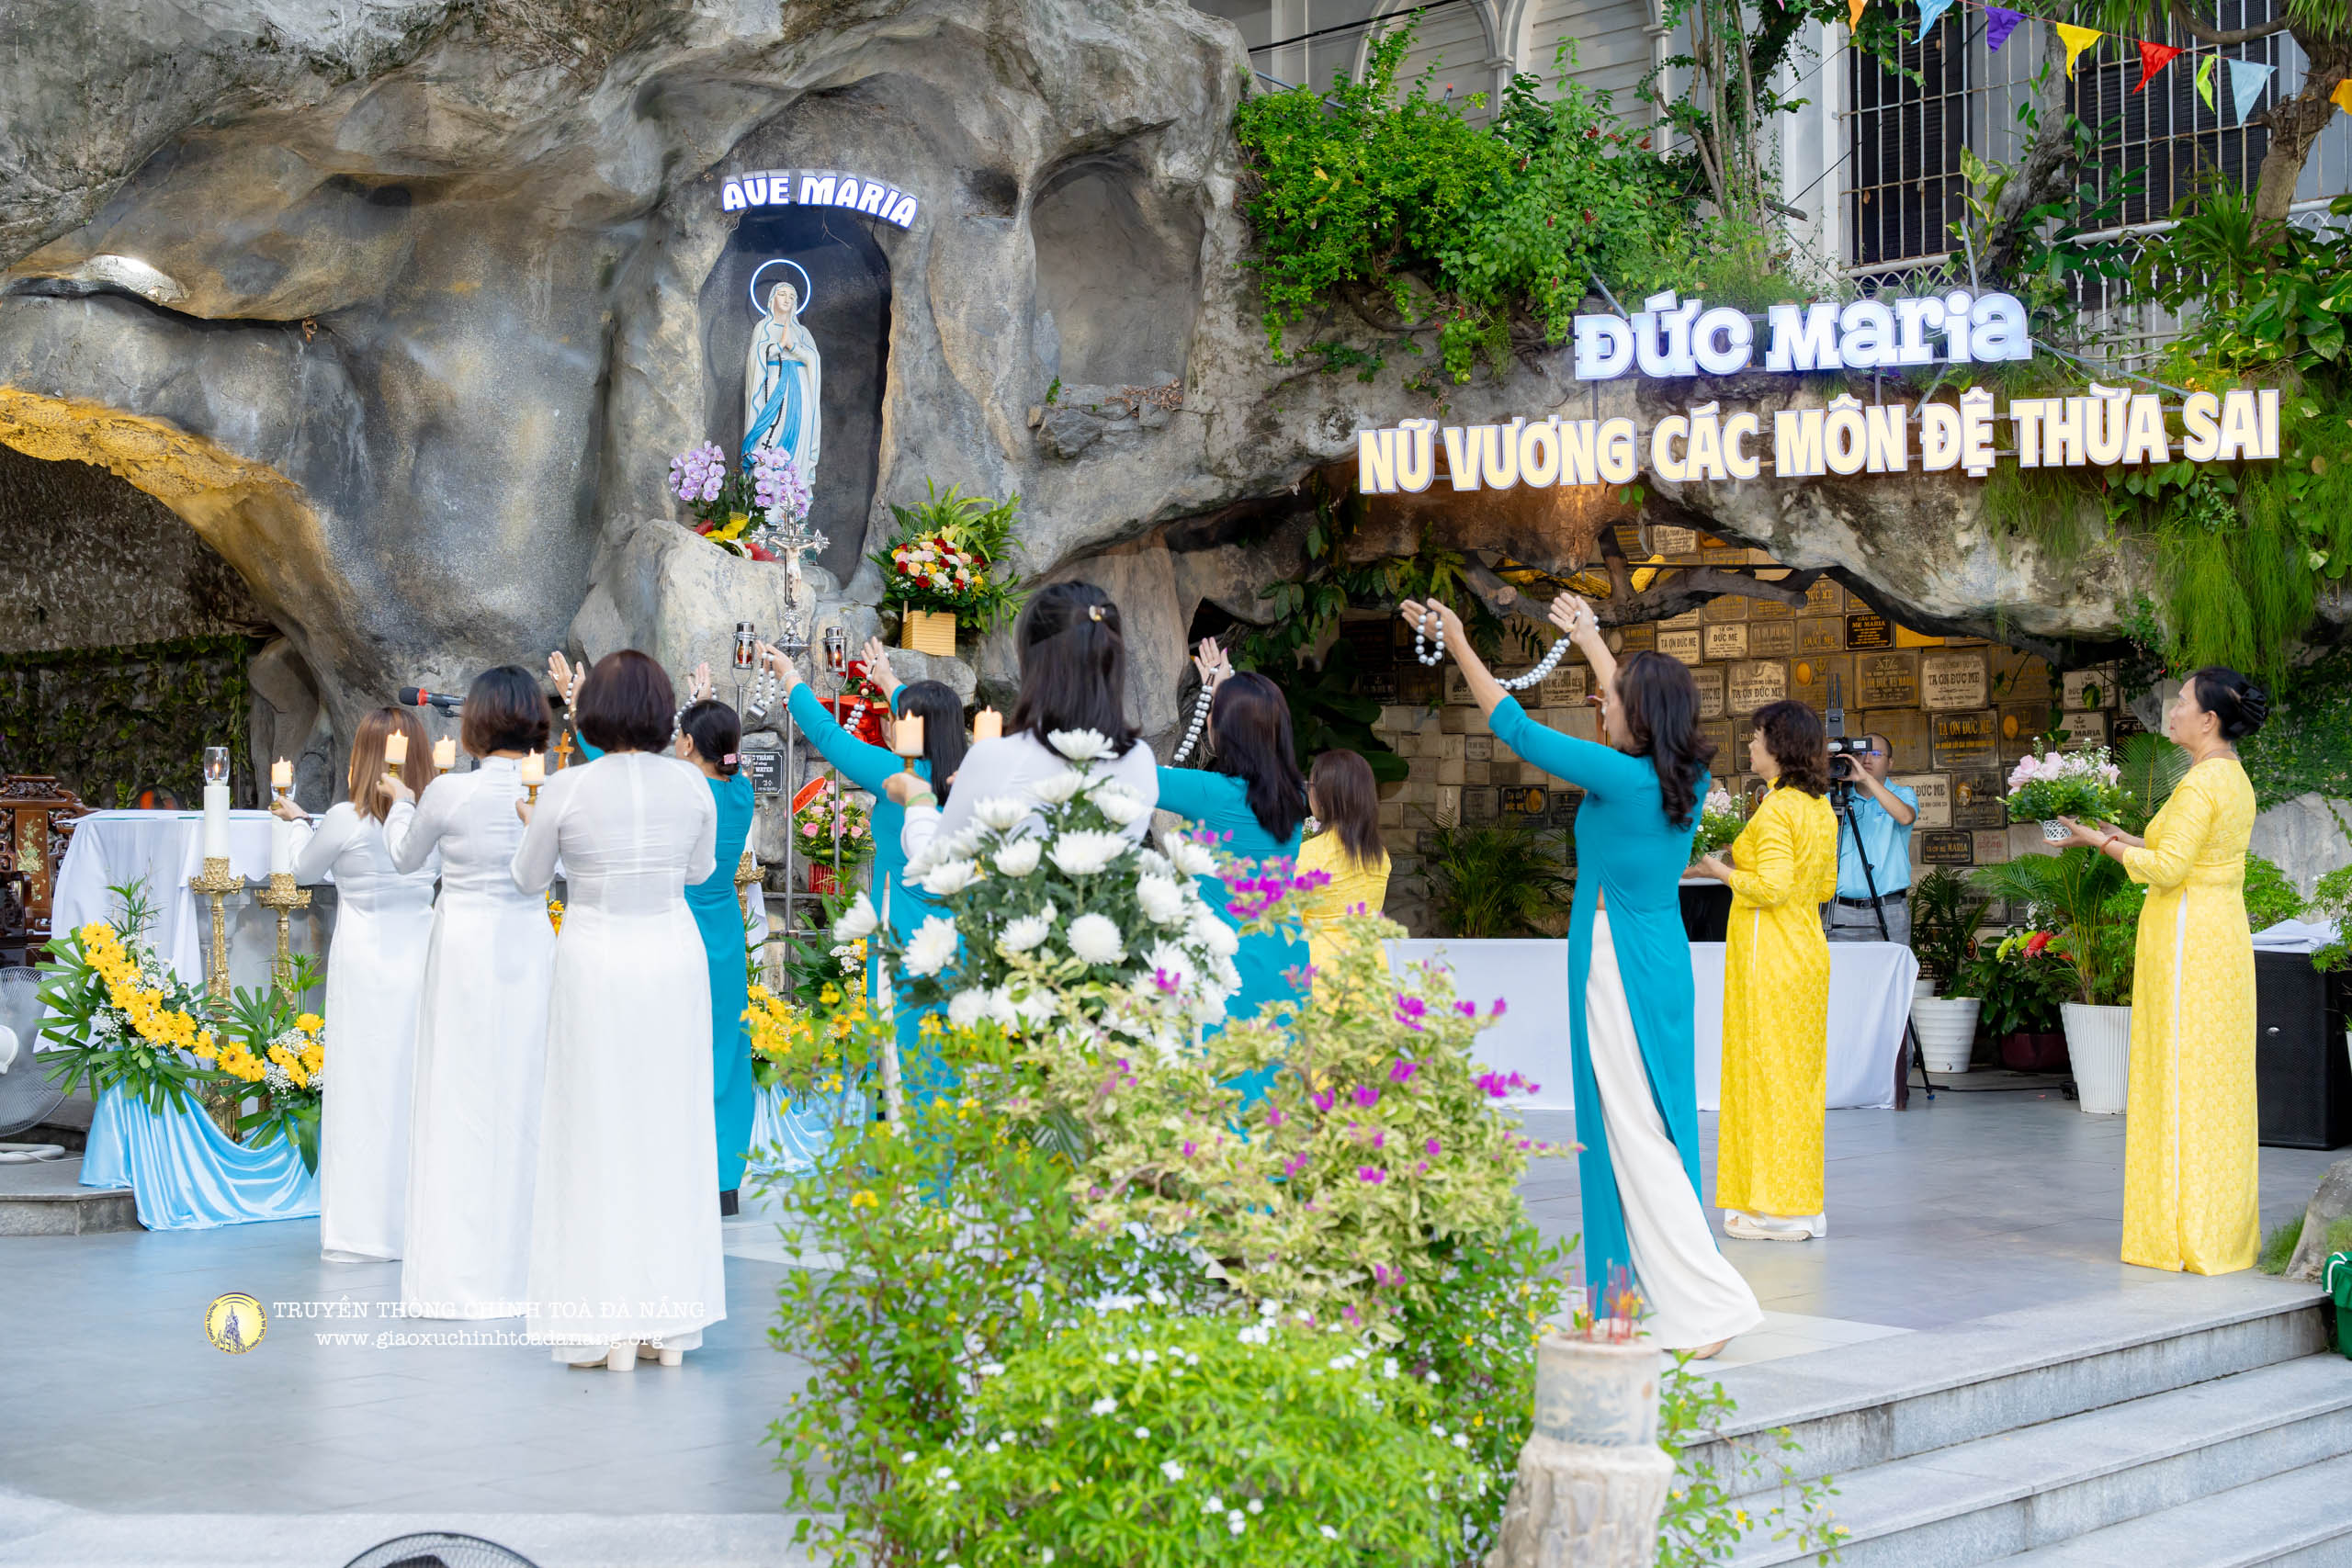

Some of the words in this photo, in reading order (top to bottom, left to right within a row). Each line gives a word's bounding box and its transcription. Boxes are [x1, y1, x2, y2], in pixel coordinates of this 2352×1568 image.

[797, 175, 918, 229] MARIA
[1766, 290, 2033, 372] Maria
[1358, 417, 1438, 494] NỮ
[1443, 414, 1638, 491] VƯƠNG
[1651, 400, 1760, 482] CÁC
[1774, 393, 1908, 477] MÔN
[1919, 386, 1996, 478] ĐỆ
[2009, 382, 2170, 468] THỪA
[2183, 389, 2280, 463] SAI
[1754, 685, 1770, 698] ĐỨC
